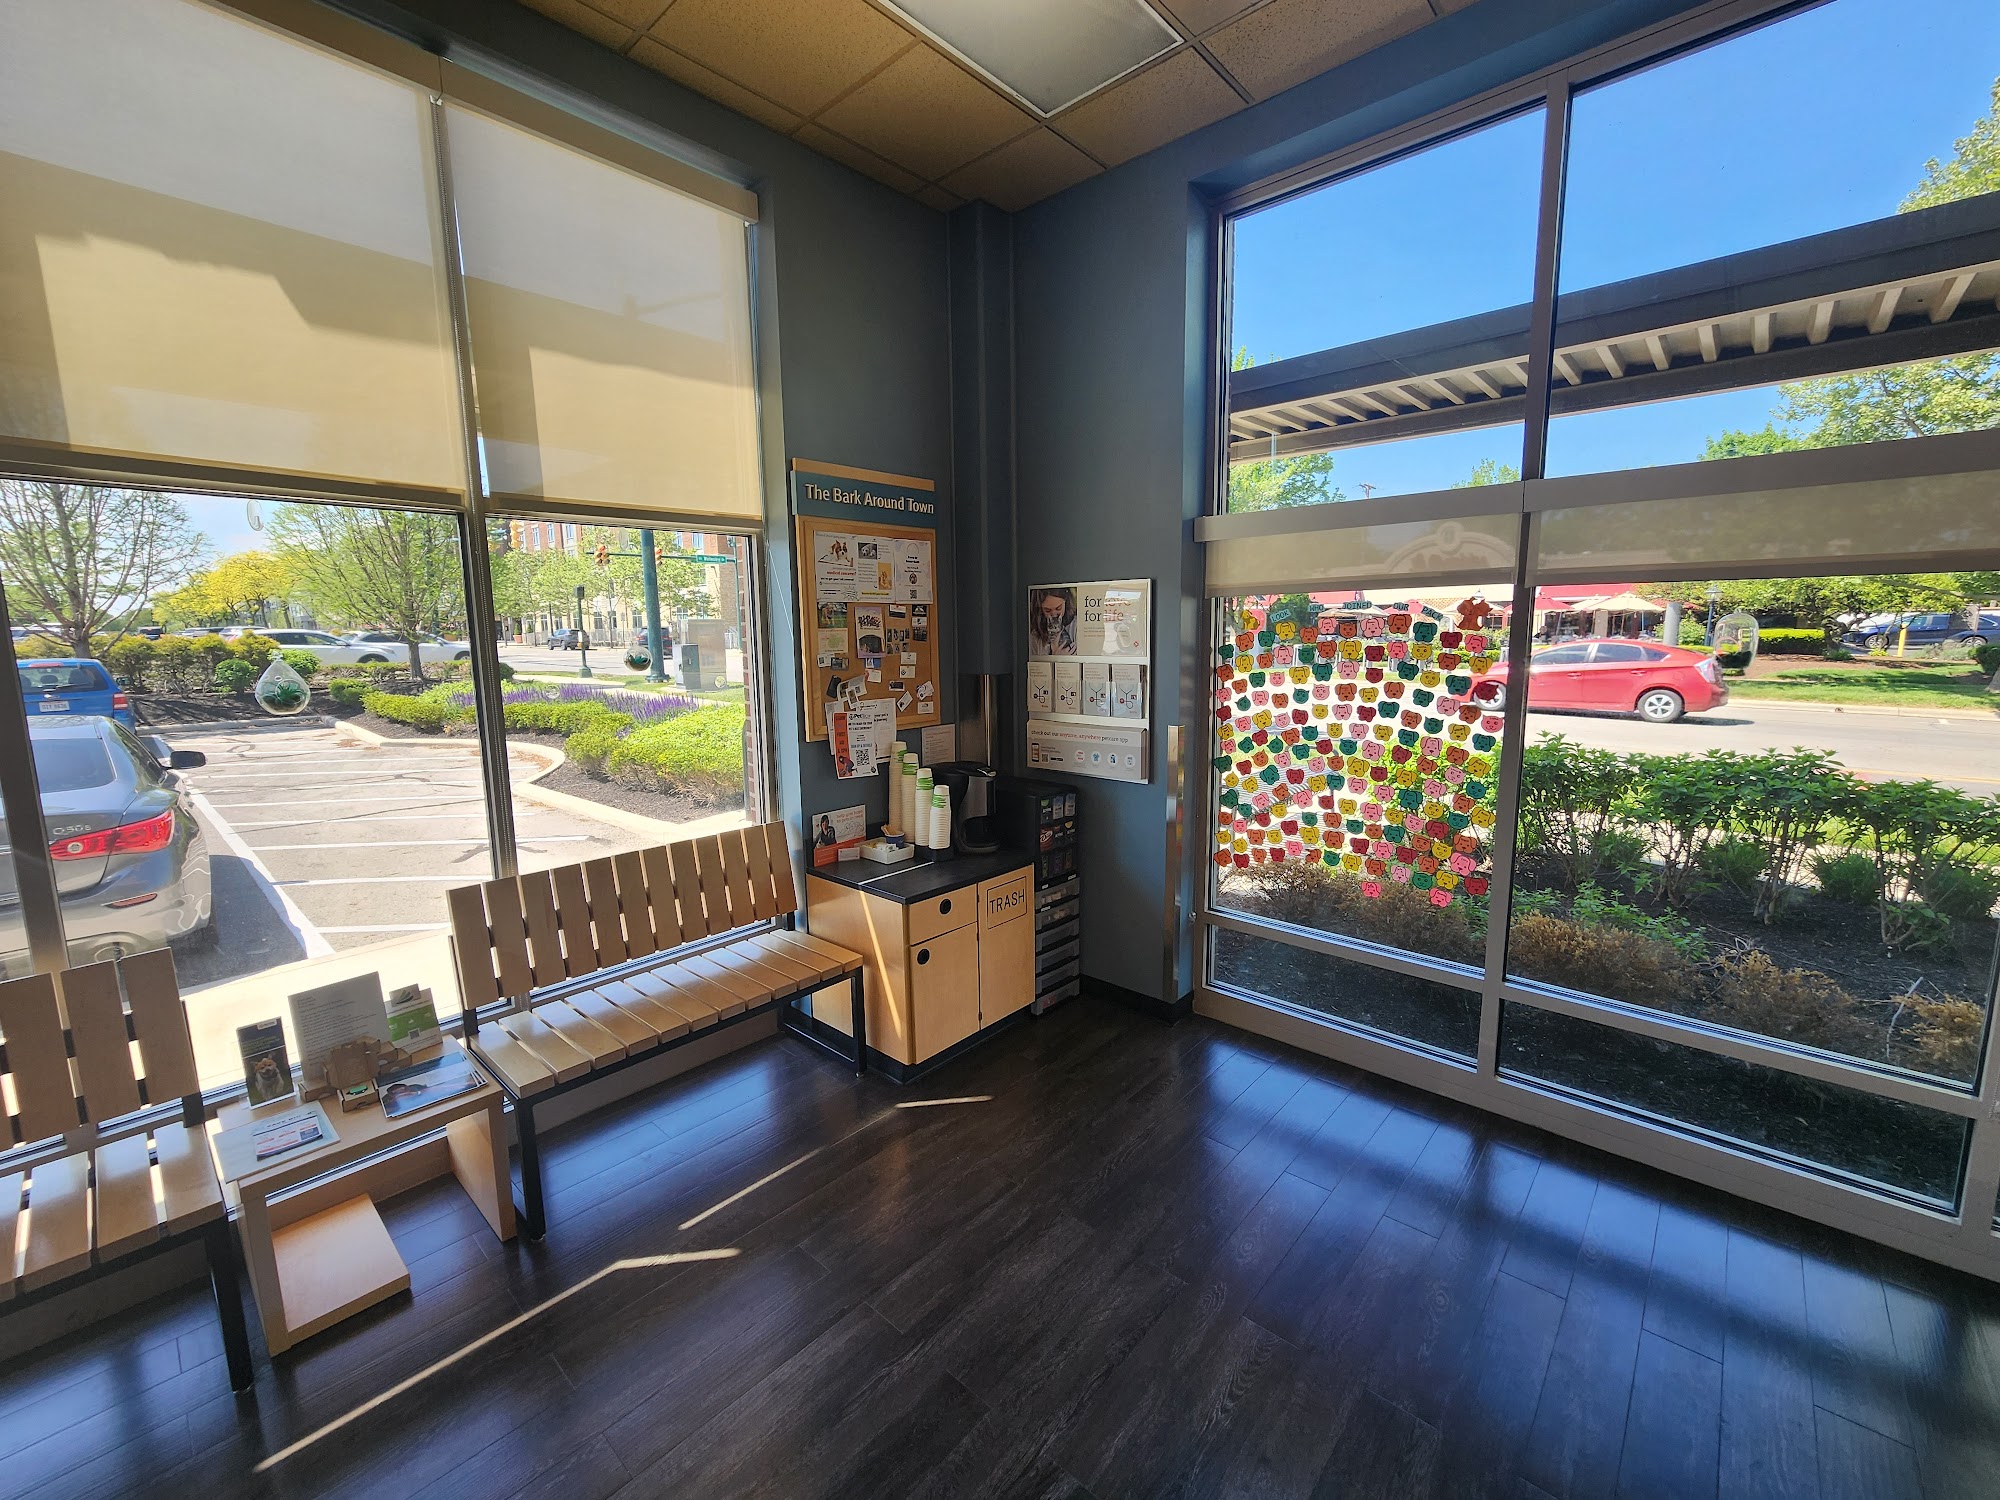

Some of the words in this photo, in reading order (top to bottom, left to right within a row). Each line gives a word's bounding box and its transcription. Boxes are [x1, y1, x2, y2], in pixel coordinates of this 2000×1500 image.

[805, 484, 830, 501] The
[832, 487, 862, 505] Bark
[863, 492, 905, 511] Around
[905, 497, 934, 514] Town
[1084, 596, 1102, 608] for
[1271, 611, 1289, 621] LOOK
[1309, 604, 1324, 612] WHO
[1343, 602, 1372, 610] JOINED
[1393, 603, 1409, 611] OUR
[1422, 607, 1443, 620] PACK
[1084, 610, 1102, 622] for
[1105, 609, 1124, 622] life
[989, 888, 1025, 914] TRASH
